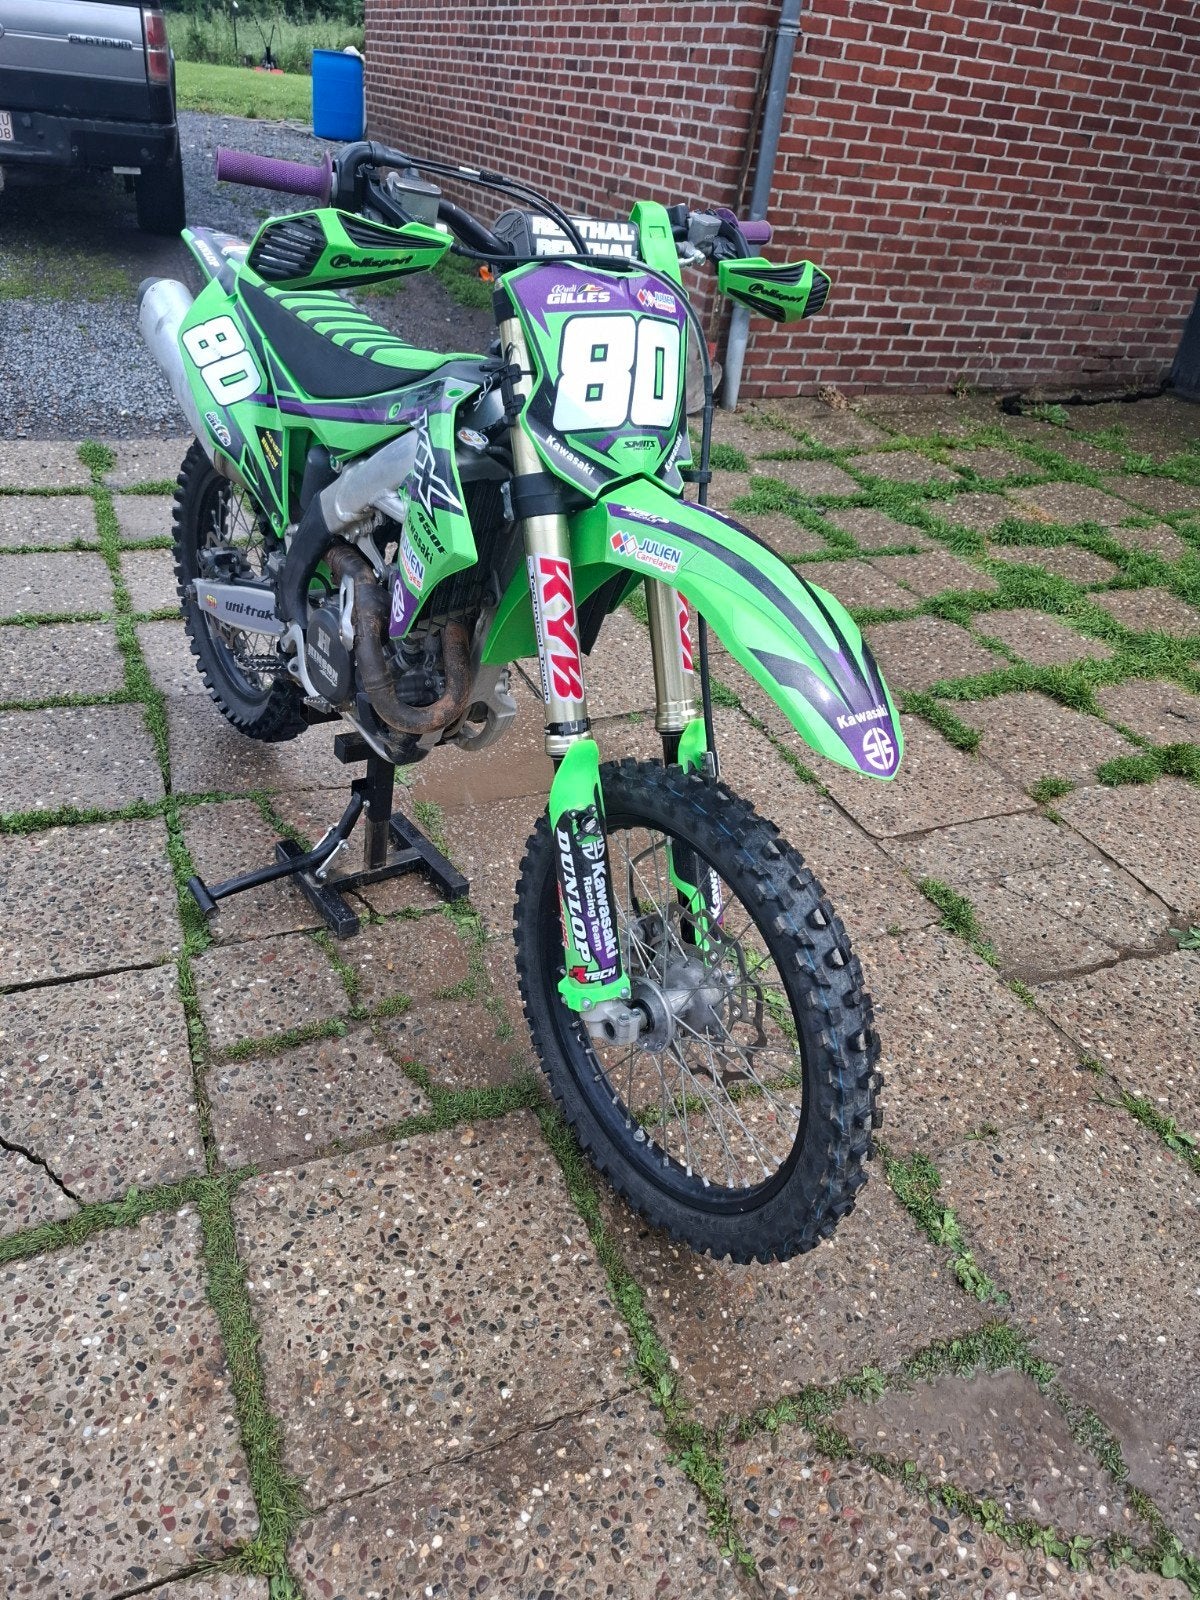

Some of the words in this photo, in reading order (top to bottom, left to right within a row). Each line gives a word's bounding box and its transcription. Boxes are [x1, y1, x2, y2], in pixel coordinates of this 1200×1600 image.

[69, 34, 132, 49] PLATINUM
[330, 254, 414, 269] Polisport
[546, 291, 611, 305] GILLES
[748, 283, 804, 303] Polisport
[181, 314, 262, 407] 80
[552, 315, 681, 431] 80
[546, 435, 595, 476] Kawasaki
[664, 431, 683, 473] Kawasaki
[636, 551, 677, 573] Carrelages
[638, 539, 681, 564] JULIEN
[540, 557, 583, 700] KYB
[836, 704, 889, 730] Kawasaki
[556, 827, 592, 962] DUNLOP
[582, 876, 597, 918] Racing
[590, 917, 603, 951] Team
[591, 860, 619, 959] Kawasaki
